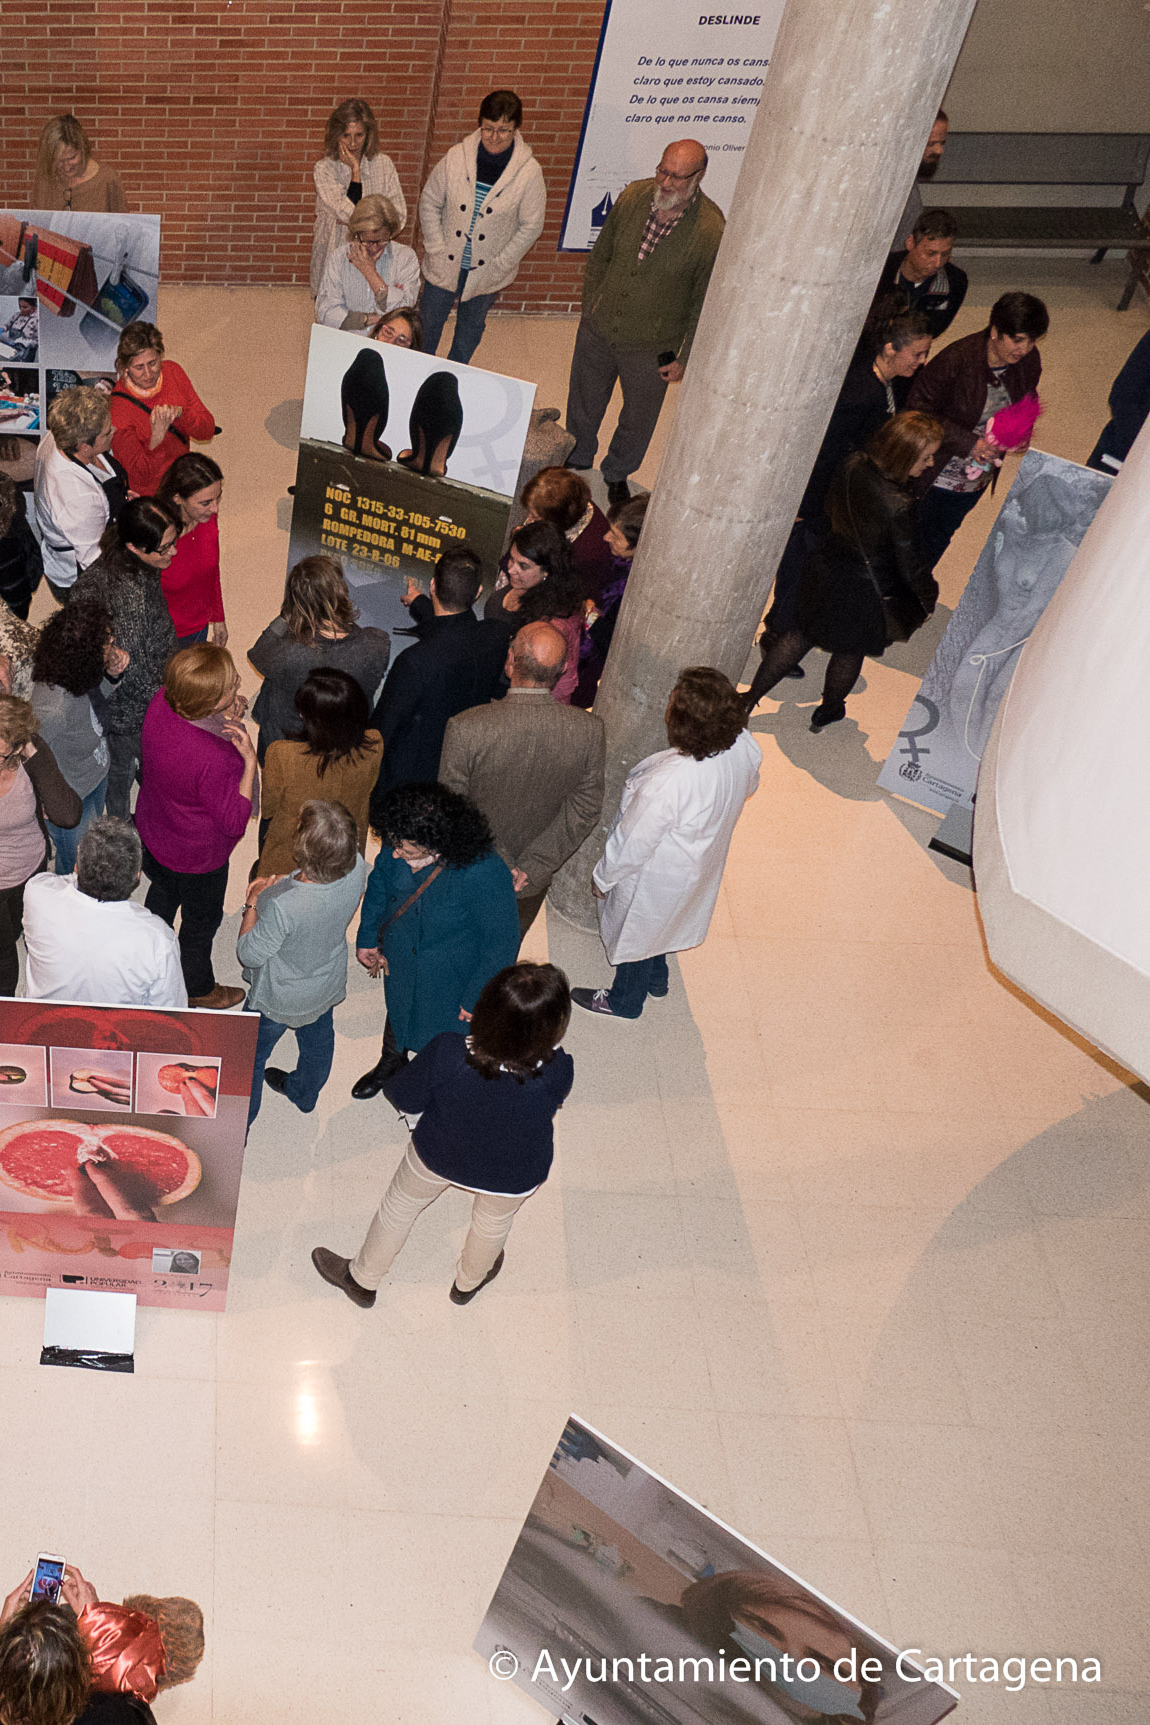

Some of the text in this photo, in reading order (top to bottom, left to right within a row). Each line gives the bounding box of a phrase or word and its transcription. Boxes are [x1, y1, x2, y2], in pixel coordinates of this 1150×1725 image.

[698, 15, 761, 25] DESLINDE
[637, 56, 770, 68] De lo que nunca os cans
[633, 75, 765, 87] claro que estoy cansado.
[629, 95, 644, 104] De
[647, 95, 657, 104] lo
[660, 96, 679, 107] que
[682, 96, 695, 104] os
[697, 96, 729, 104] cansa
[625, 113, 746, 125] claro que no me canso.
[703, 144, 720, 152] onio
[324, 502, 333, 515] 6
[340, 507, 360, 524] GR.
[362, 514, 399, 536] MORT.
[326, 486, 466, 540] NOC 1315-33-105-7530
[322, 518, 395, 551] ROMPEDORA
[321, 533, 348, 552] LOTE
[352, 543, 400, 568] 23-B-06
[922, 777, 962, 798] Cartagena
[3, 1274, 52, 1282] Cartagena
[89, 1276, 142, 1285] UNIVERSIDAD
